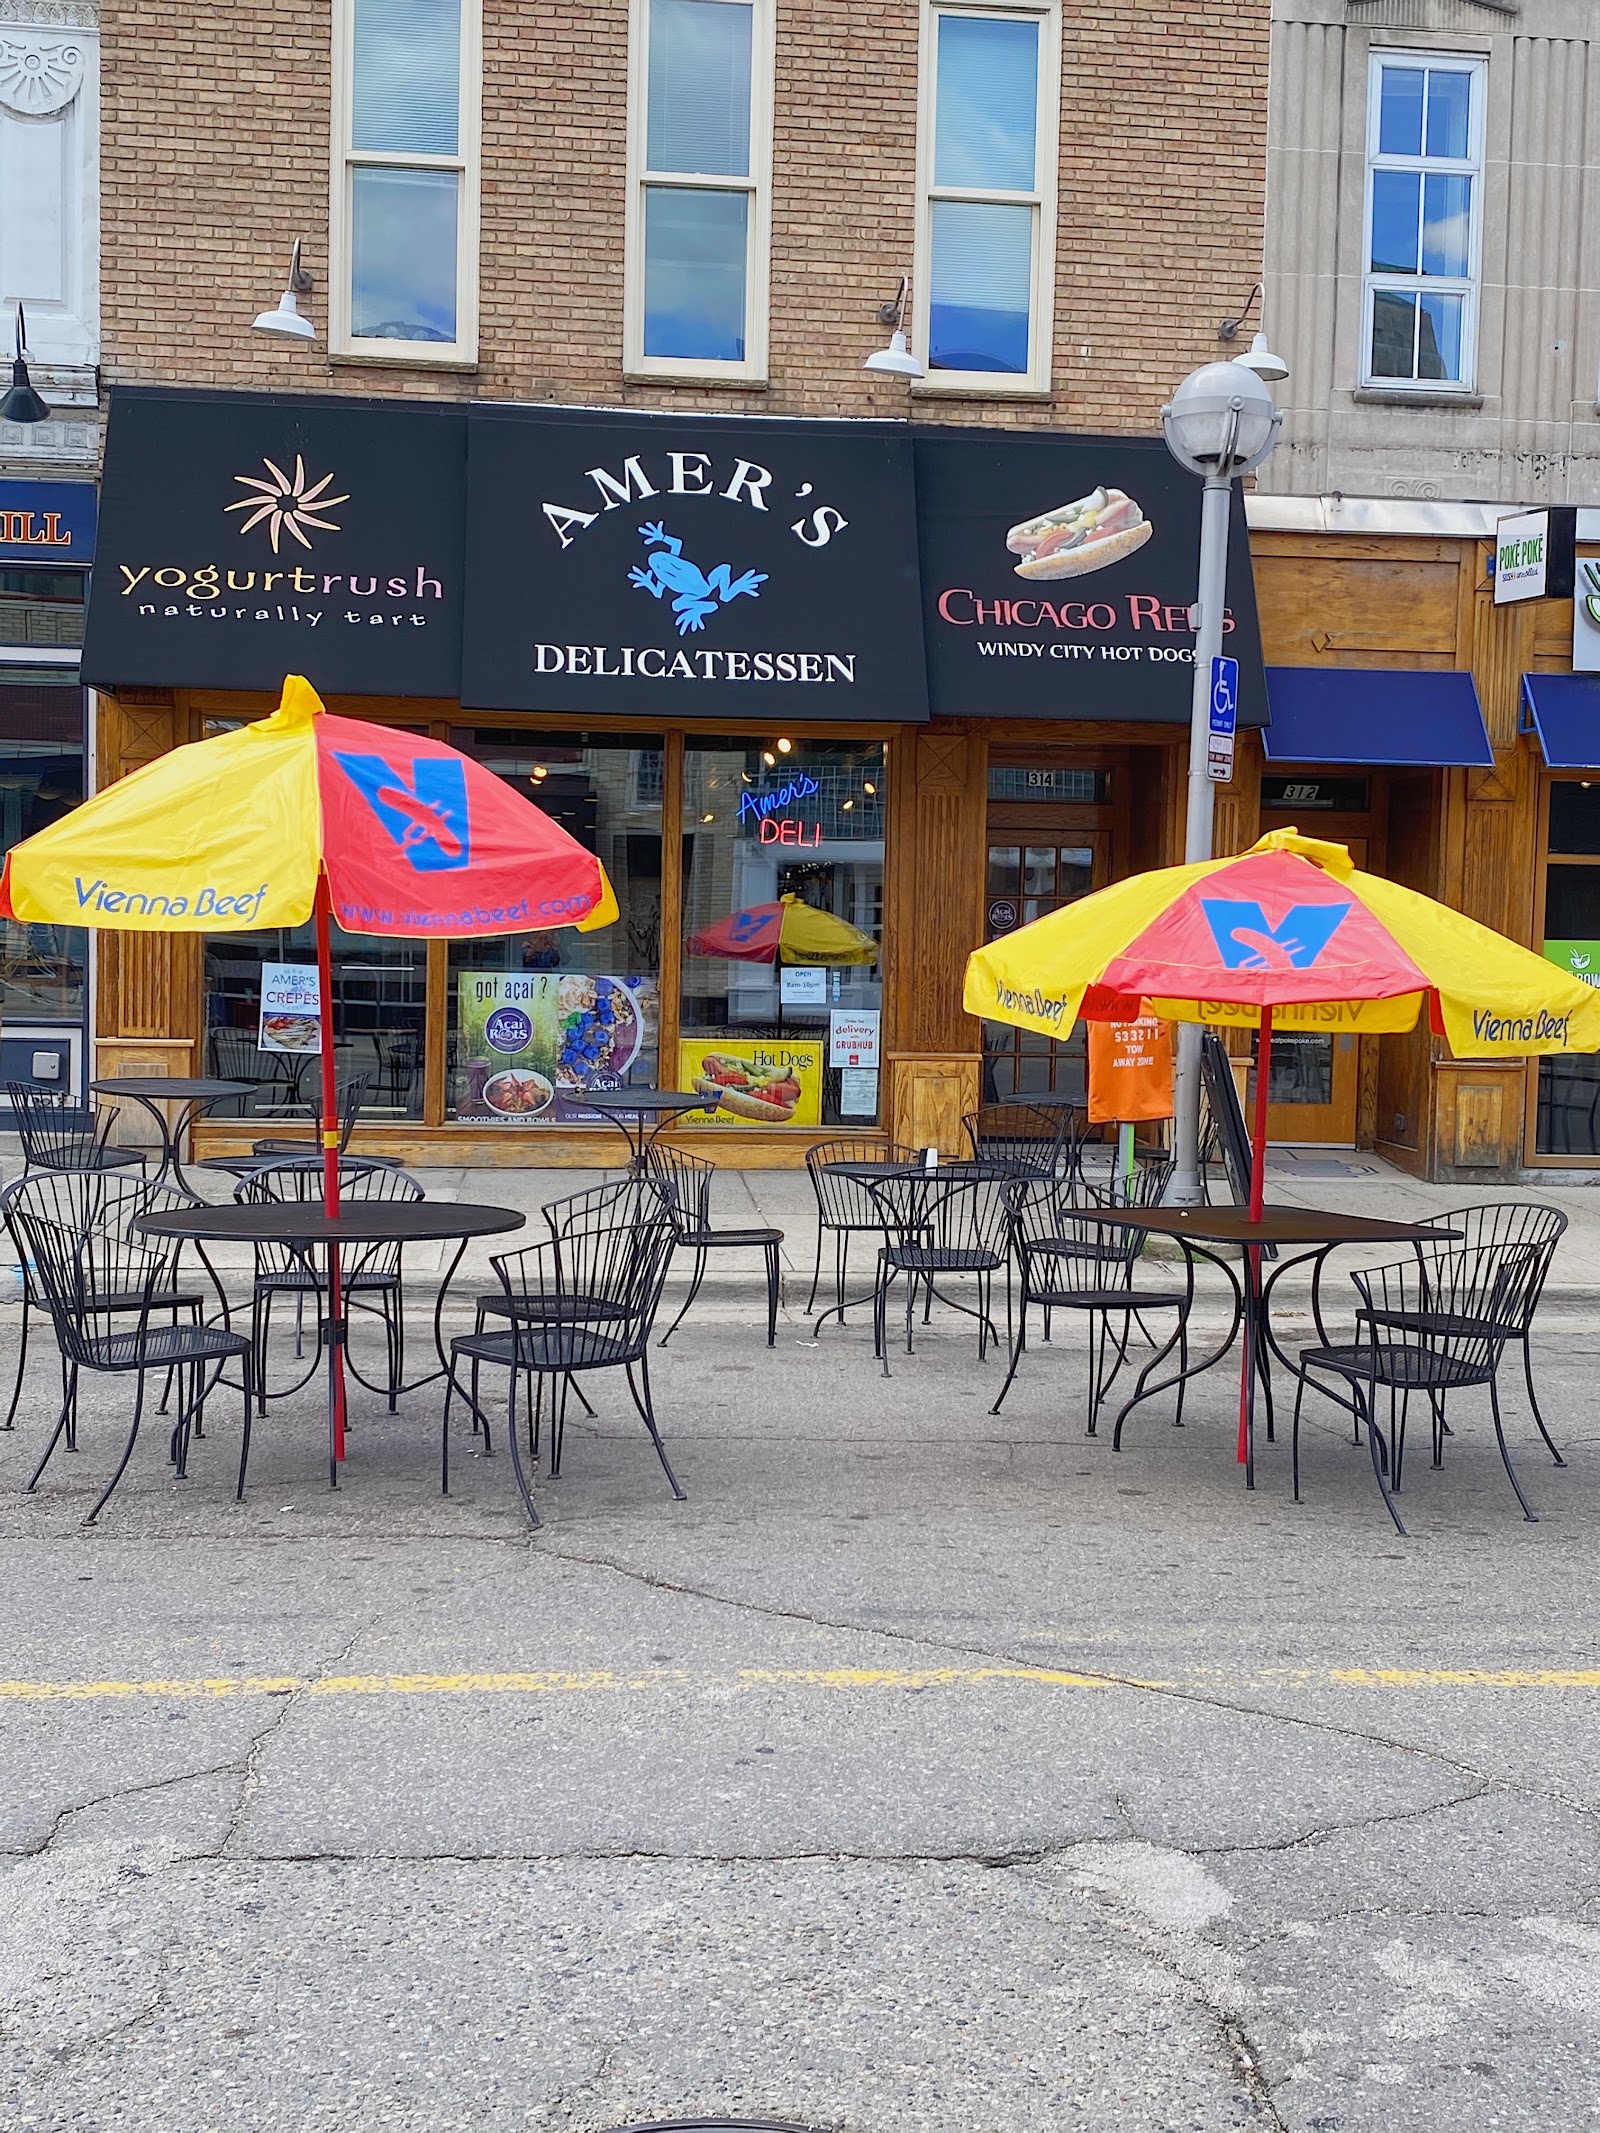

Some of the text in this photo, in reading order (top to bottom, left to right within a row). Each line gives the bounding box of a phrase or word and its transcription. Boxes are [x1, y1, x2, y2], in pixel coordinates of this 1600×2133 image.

[541, 452, 849, 549] AMER'S
[139, 603, 426, 626] naturally tart
[938, 588, 1117, 630] CHICAGO
[534, 644, 856, 682] DELICATESSEN
[977, 641, 1044, 657] WINDY
[1050, 645, 1095, 660] CITY
[1100, 646, 1143, 661] HOT
[1030, 773, 1052, 786] 314
[736, 773, 818, 824] Amer's
[1286, 785, 1317, 799] 312
[760, 818, 822, 848] DELI
[75, 877, 268, 923] Vienna Beef
[339, 894, 592, 927] www.viennabeef.com
[271, 975, 316, 987] AMER'S
[476, 977, 498, 1002] got
[835, 1024, 875, 1036] delivery
[1473, 1009, 1573, 1047] Vienna Beef
[835, 1040, 873, 1050] GRUBHUB
[752, 1050, 814, 1072] Hot Dogs
[1112, 1057, 1136, 1068] AWAY
